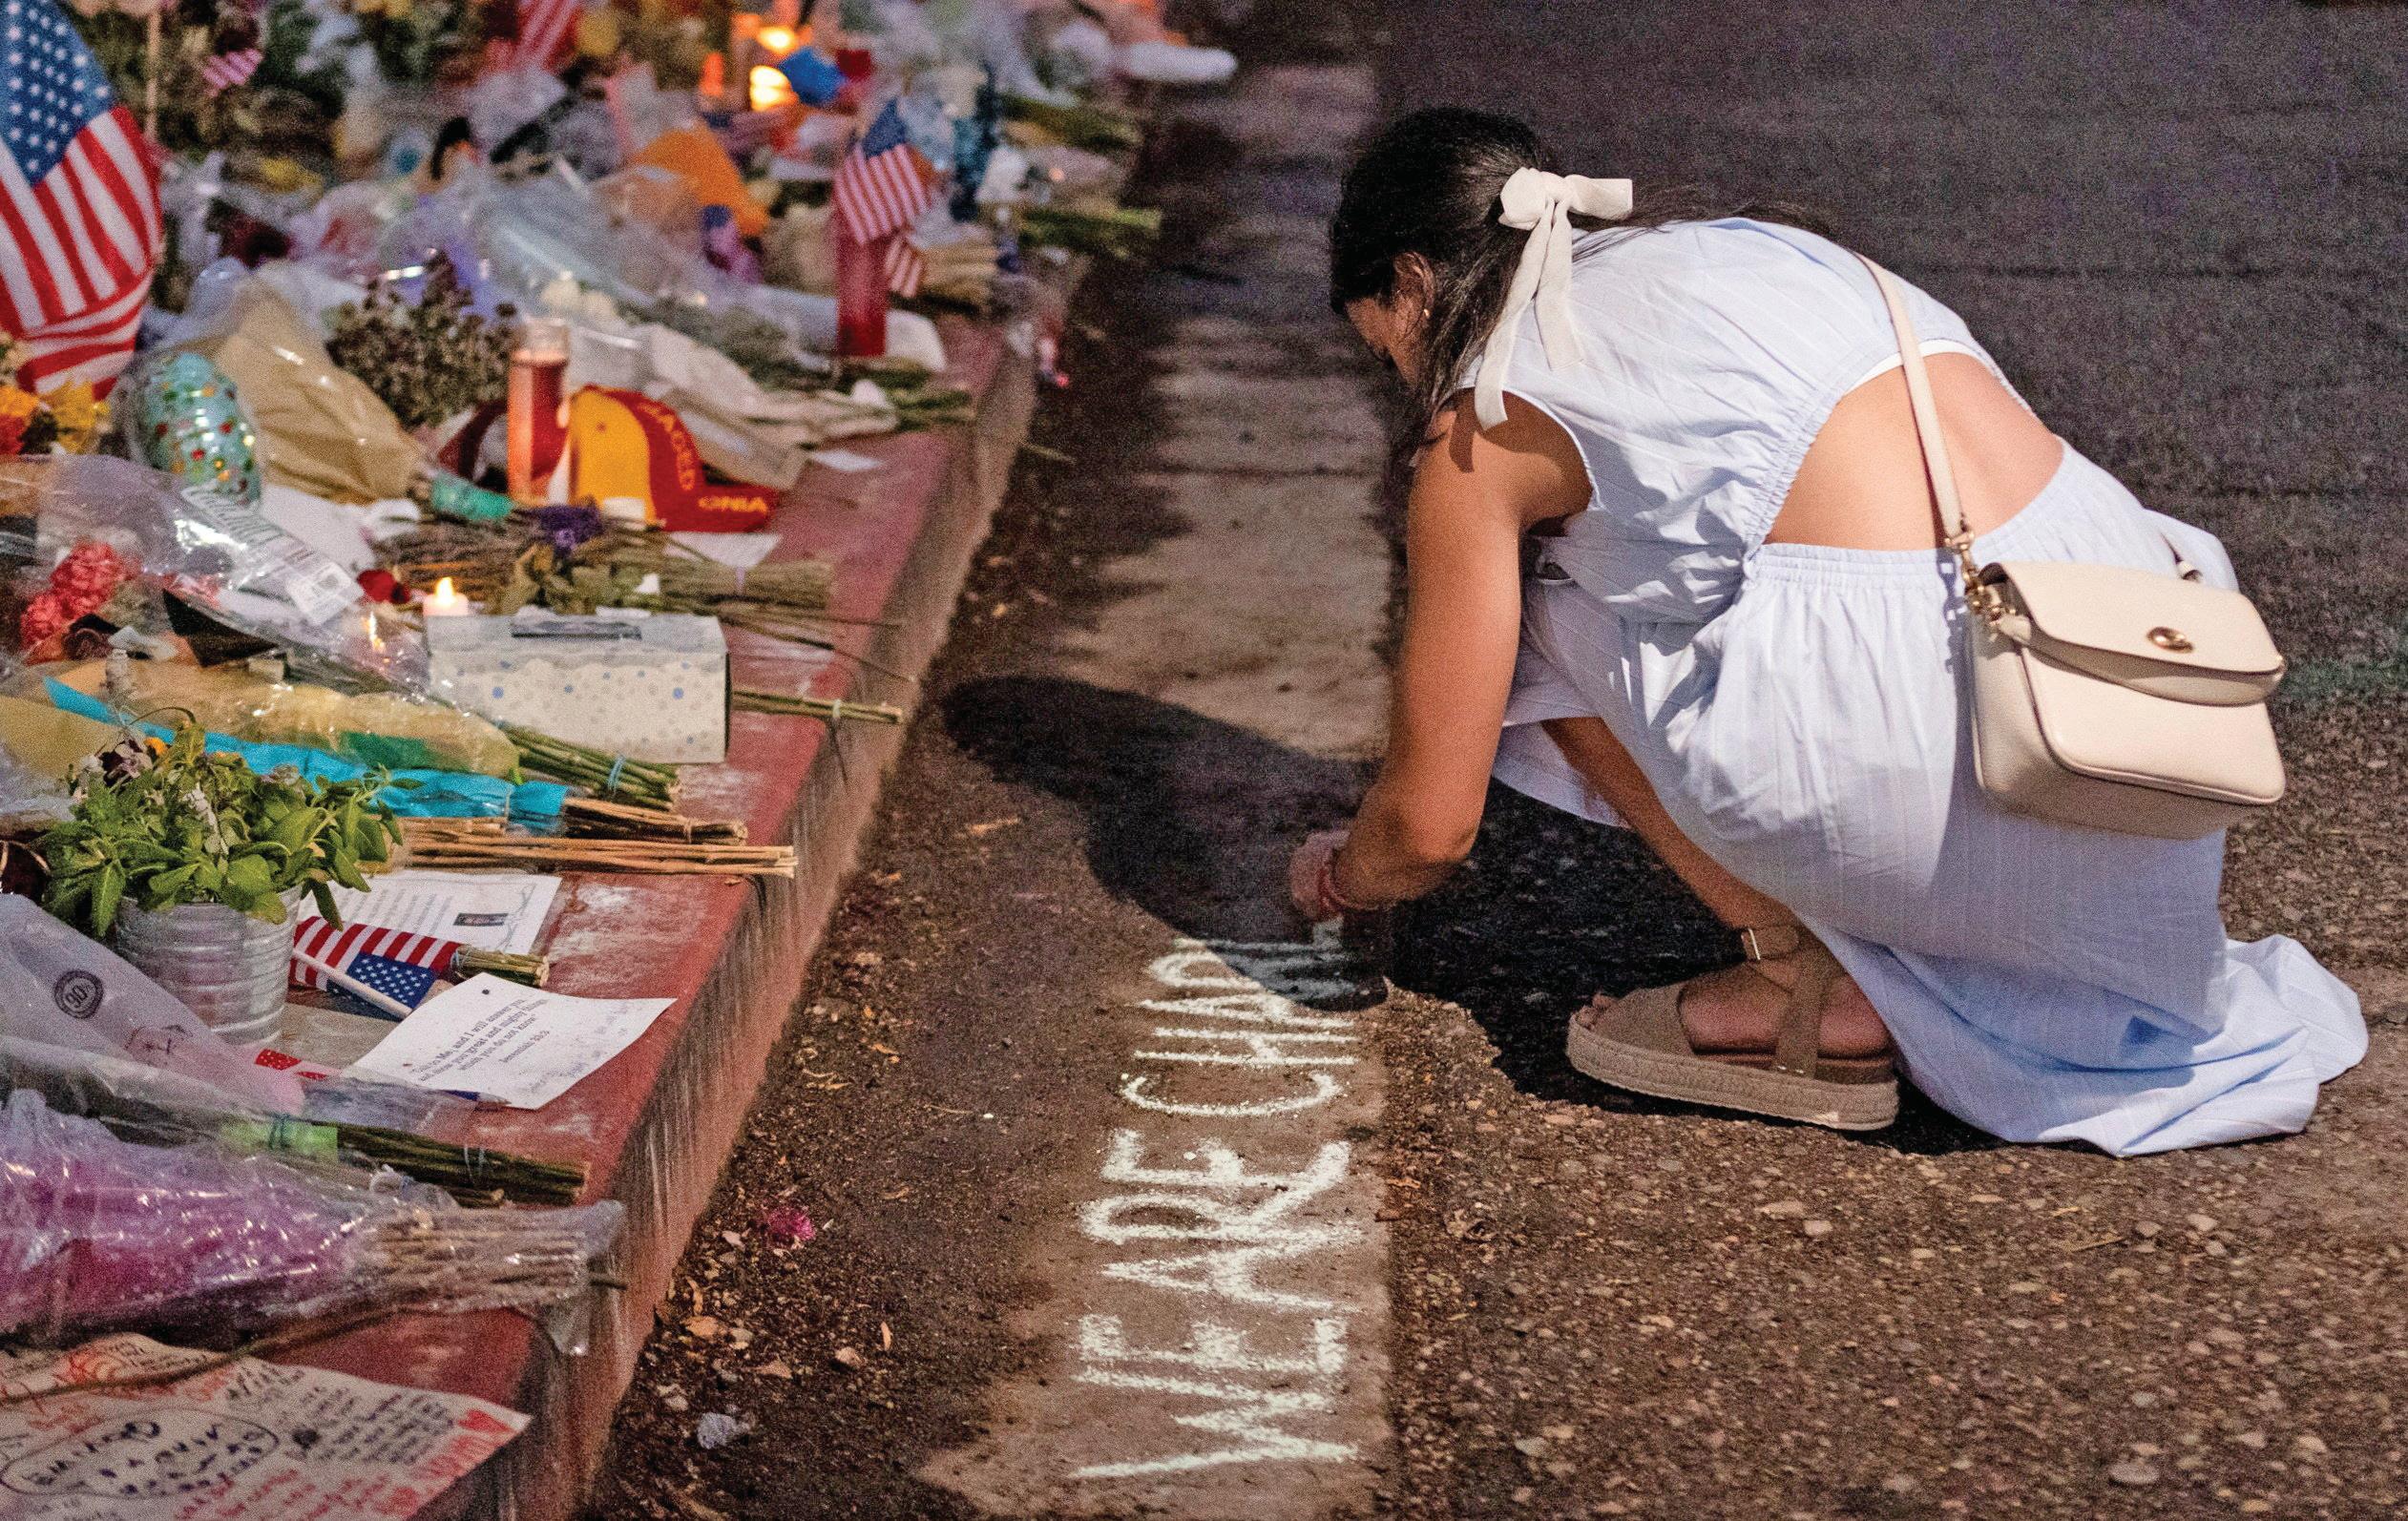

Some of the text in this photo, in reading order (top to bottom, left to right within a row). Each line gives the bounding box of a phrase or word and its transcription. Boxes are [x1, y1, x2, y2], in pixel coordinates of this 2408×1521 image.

[1067, 920, 1365, 1478] WE ARE CHARL
